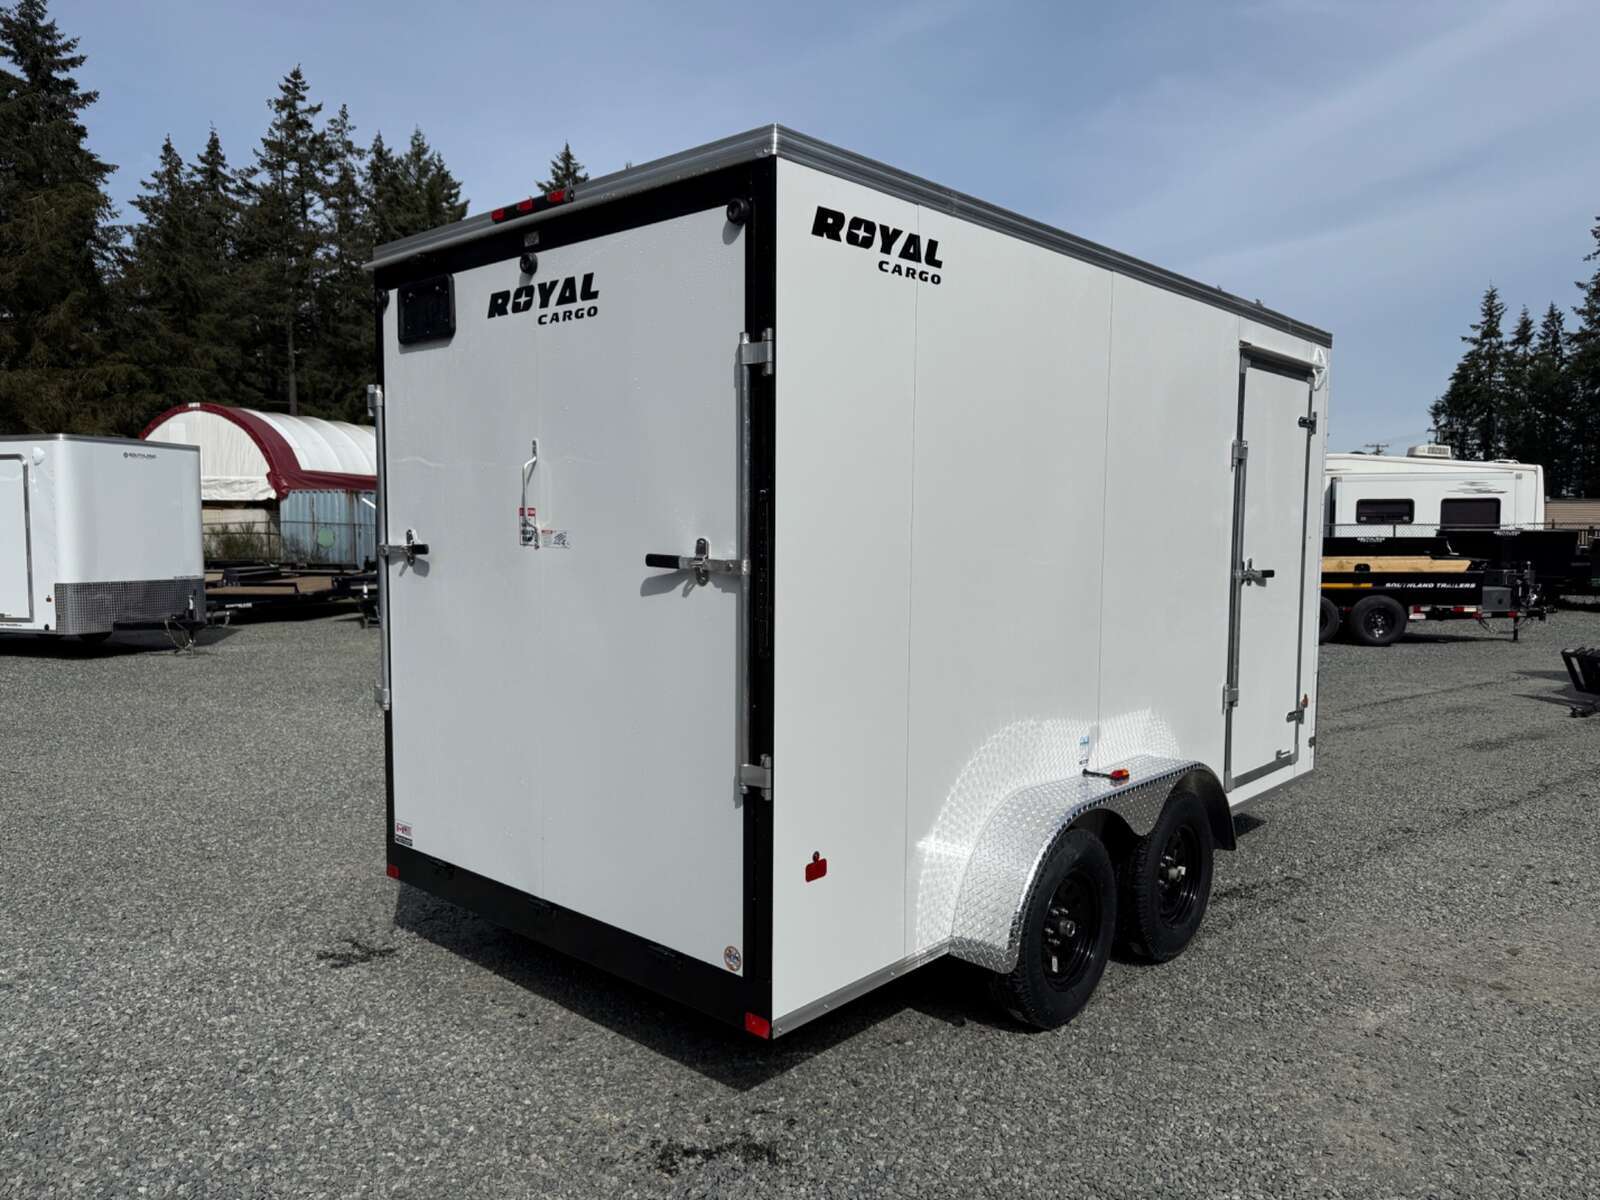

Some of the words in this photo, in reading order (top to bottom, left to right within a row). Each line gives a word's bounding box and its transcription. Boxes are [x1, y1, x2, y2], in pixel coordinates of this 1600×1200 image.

[811, 205, 943, 270] ROYAL
[878, 260, 942, 286] CARGO
[487, 272, 600, 319] ROYAL
[537, 305, 599, 326] CARGO
